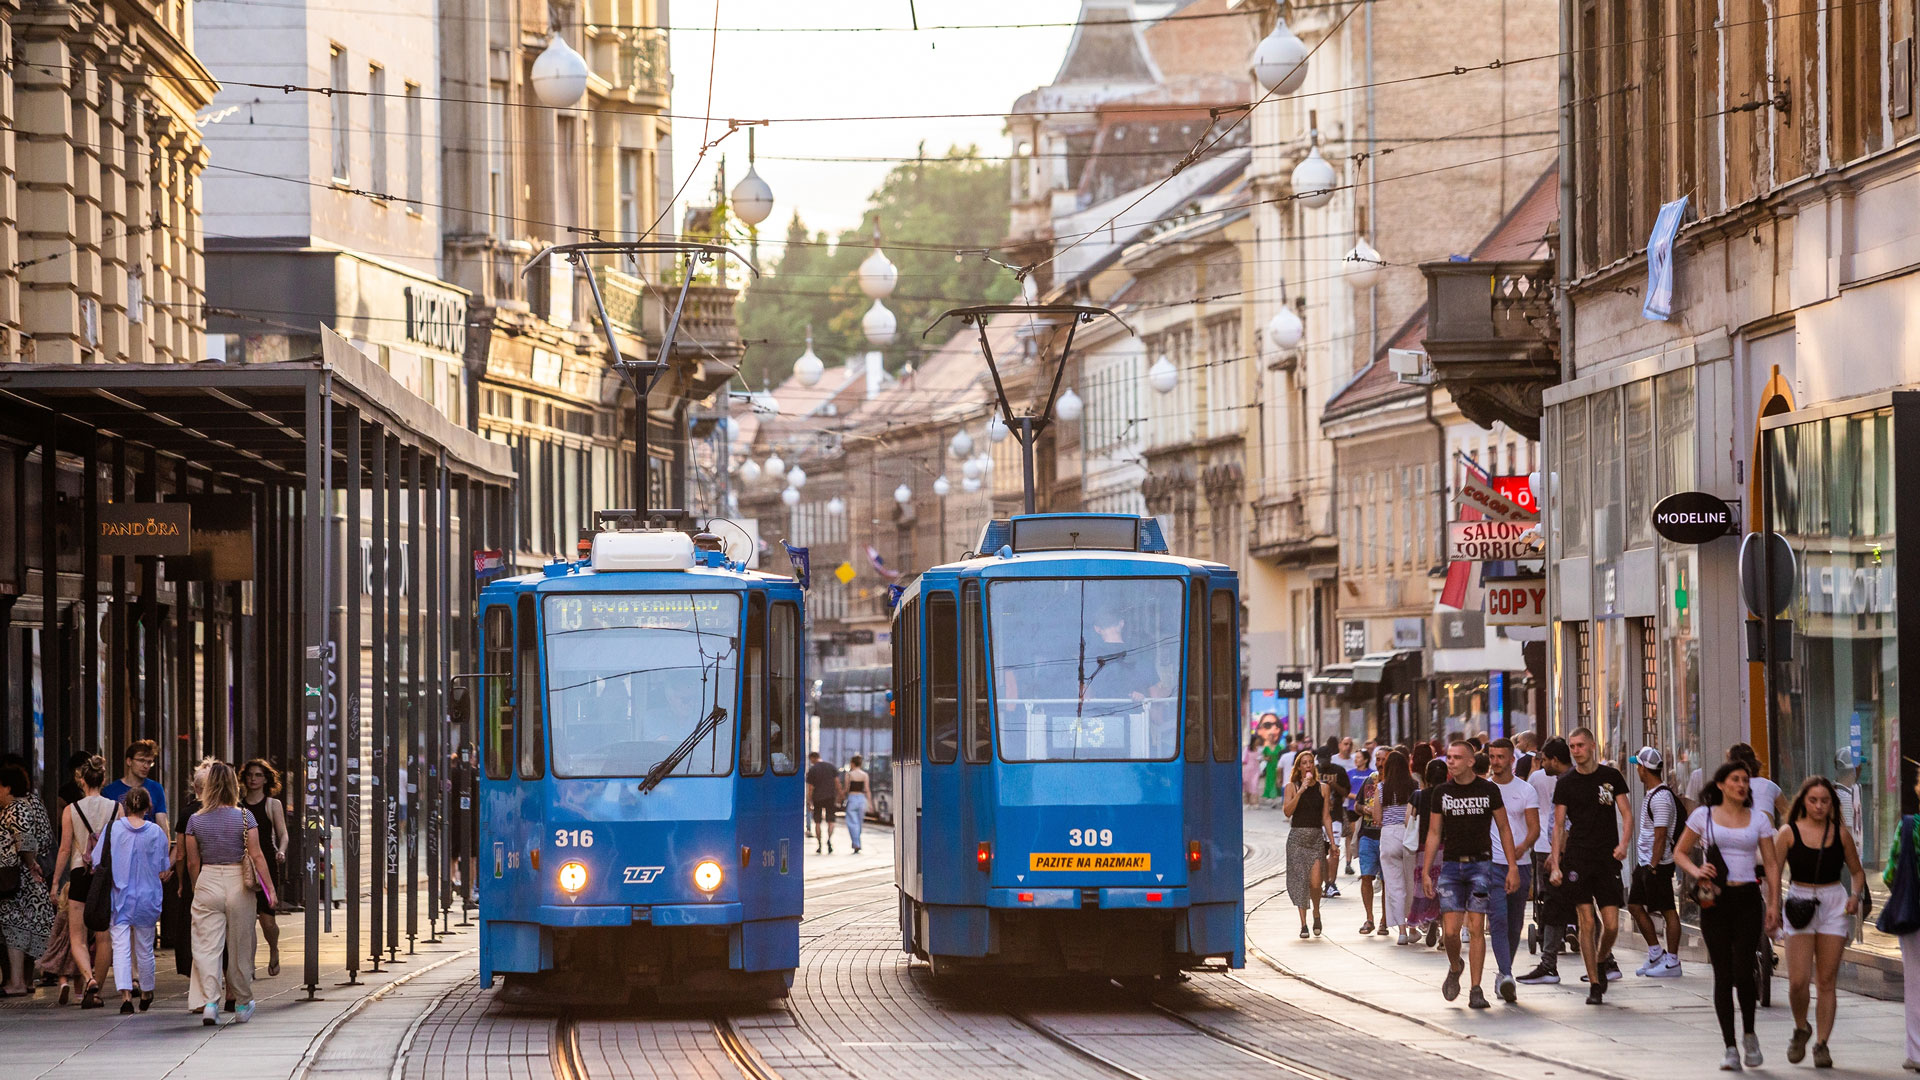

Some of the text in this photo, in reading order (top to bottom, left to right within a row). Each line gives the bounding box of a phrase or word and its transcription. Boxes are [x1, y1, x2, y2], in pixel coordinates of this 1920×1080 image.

[101, 518, 180, 536] PANDORA
[1657, 512, 1726, 524] MODELINE
[1463, 522, 1524, 541] SALON
[1489, 588, 1546, 615] COPY
[557, 599, 583, 630] 13
[1447, 797, 1490, 810] BOXEUR
[1452, 807, 1484, 816] DES RUES
[555, 829, 593, 847] 316
[1069, 828, 1113, 847] 309
[507, 852, 520, 869] 316
[762, 849, 775, 867] 316
[1036, 857, 1145, 868] PAZITE NA RAZMAK!
